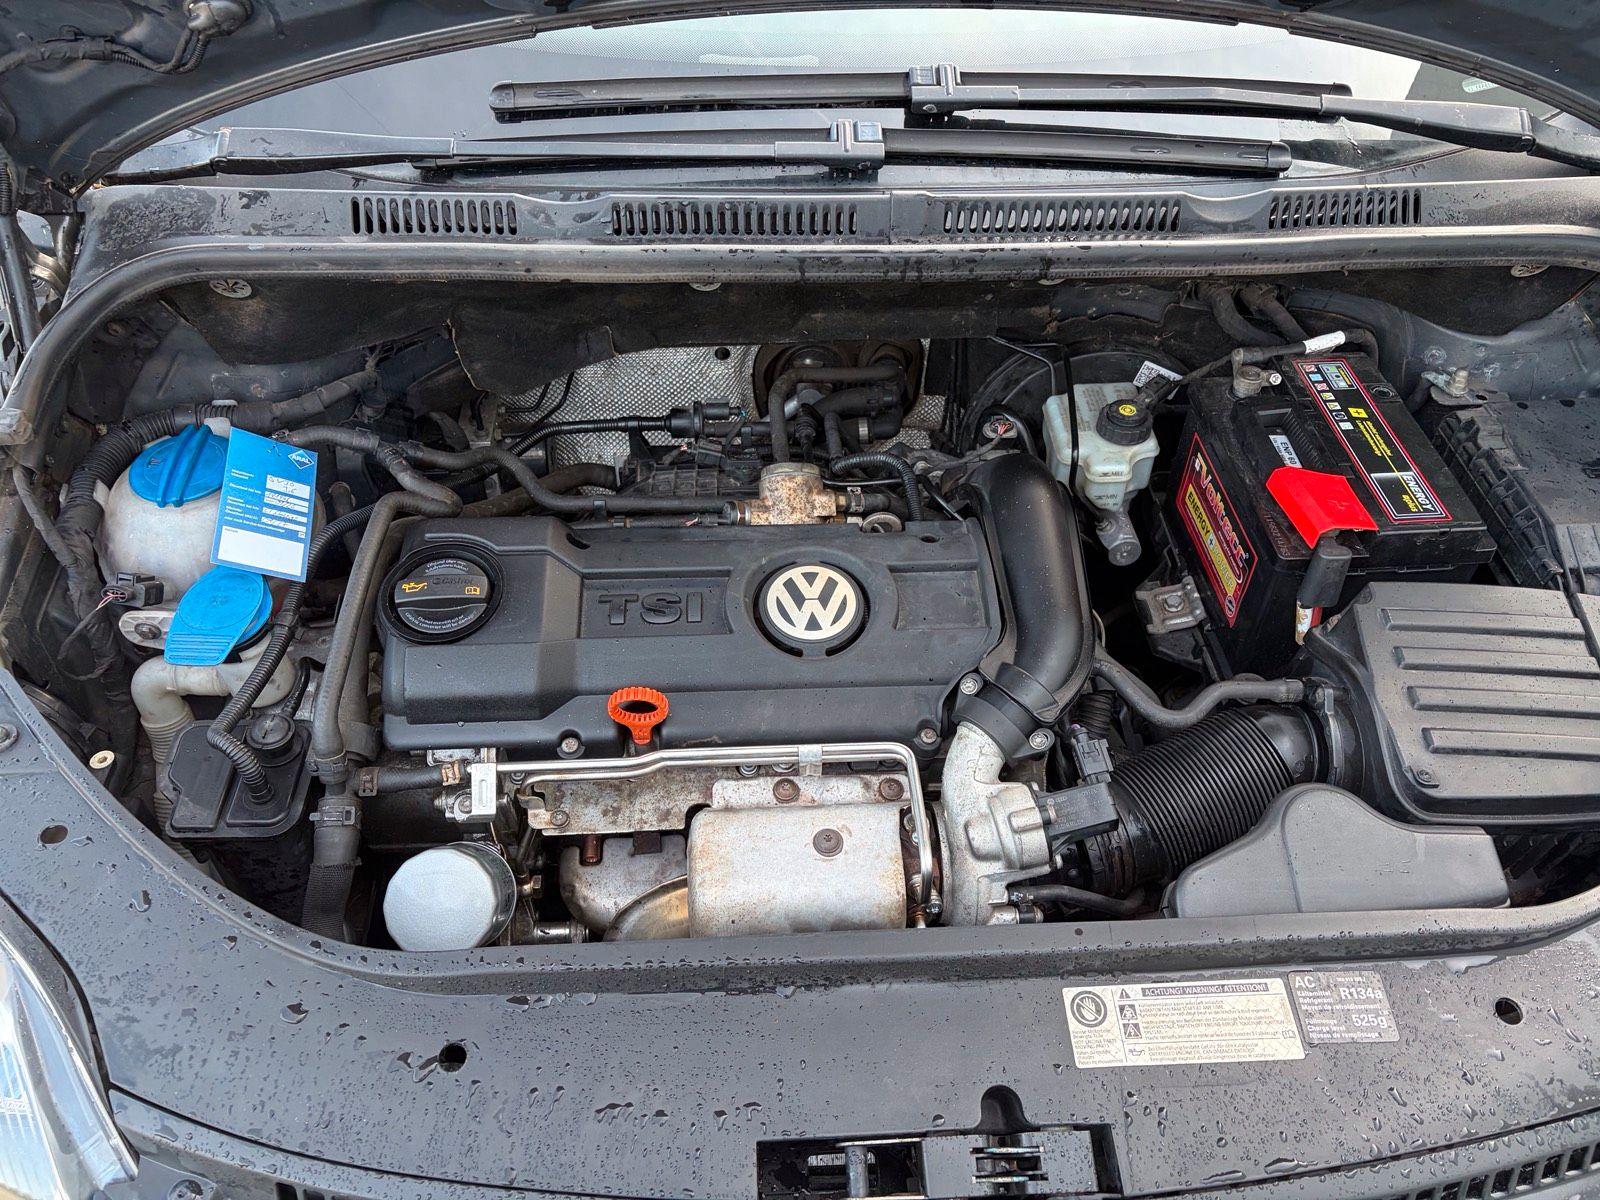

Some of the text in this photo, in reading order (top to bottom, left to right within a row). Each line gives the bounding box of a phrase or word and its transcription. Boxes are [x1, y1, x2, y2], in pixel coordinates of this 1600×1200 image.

[291, 454, 311, 464] ARAL
[1402, 475, 1435, 511] ENERGY
[1187, 491, 1210, 536] ENERGY
[598, 592, 703, 625] TSI
[1295, 976, 1315, 988] AC
[1145, 983, 1267, 996] ACHTUNG! WARNING! ATTENTION!
[1340, 988, 1383, 1000] R134a
